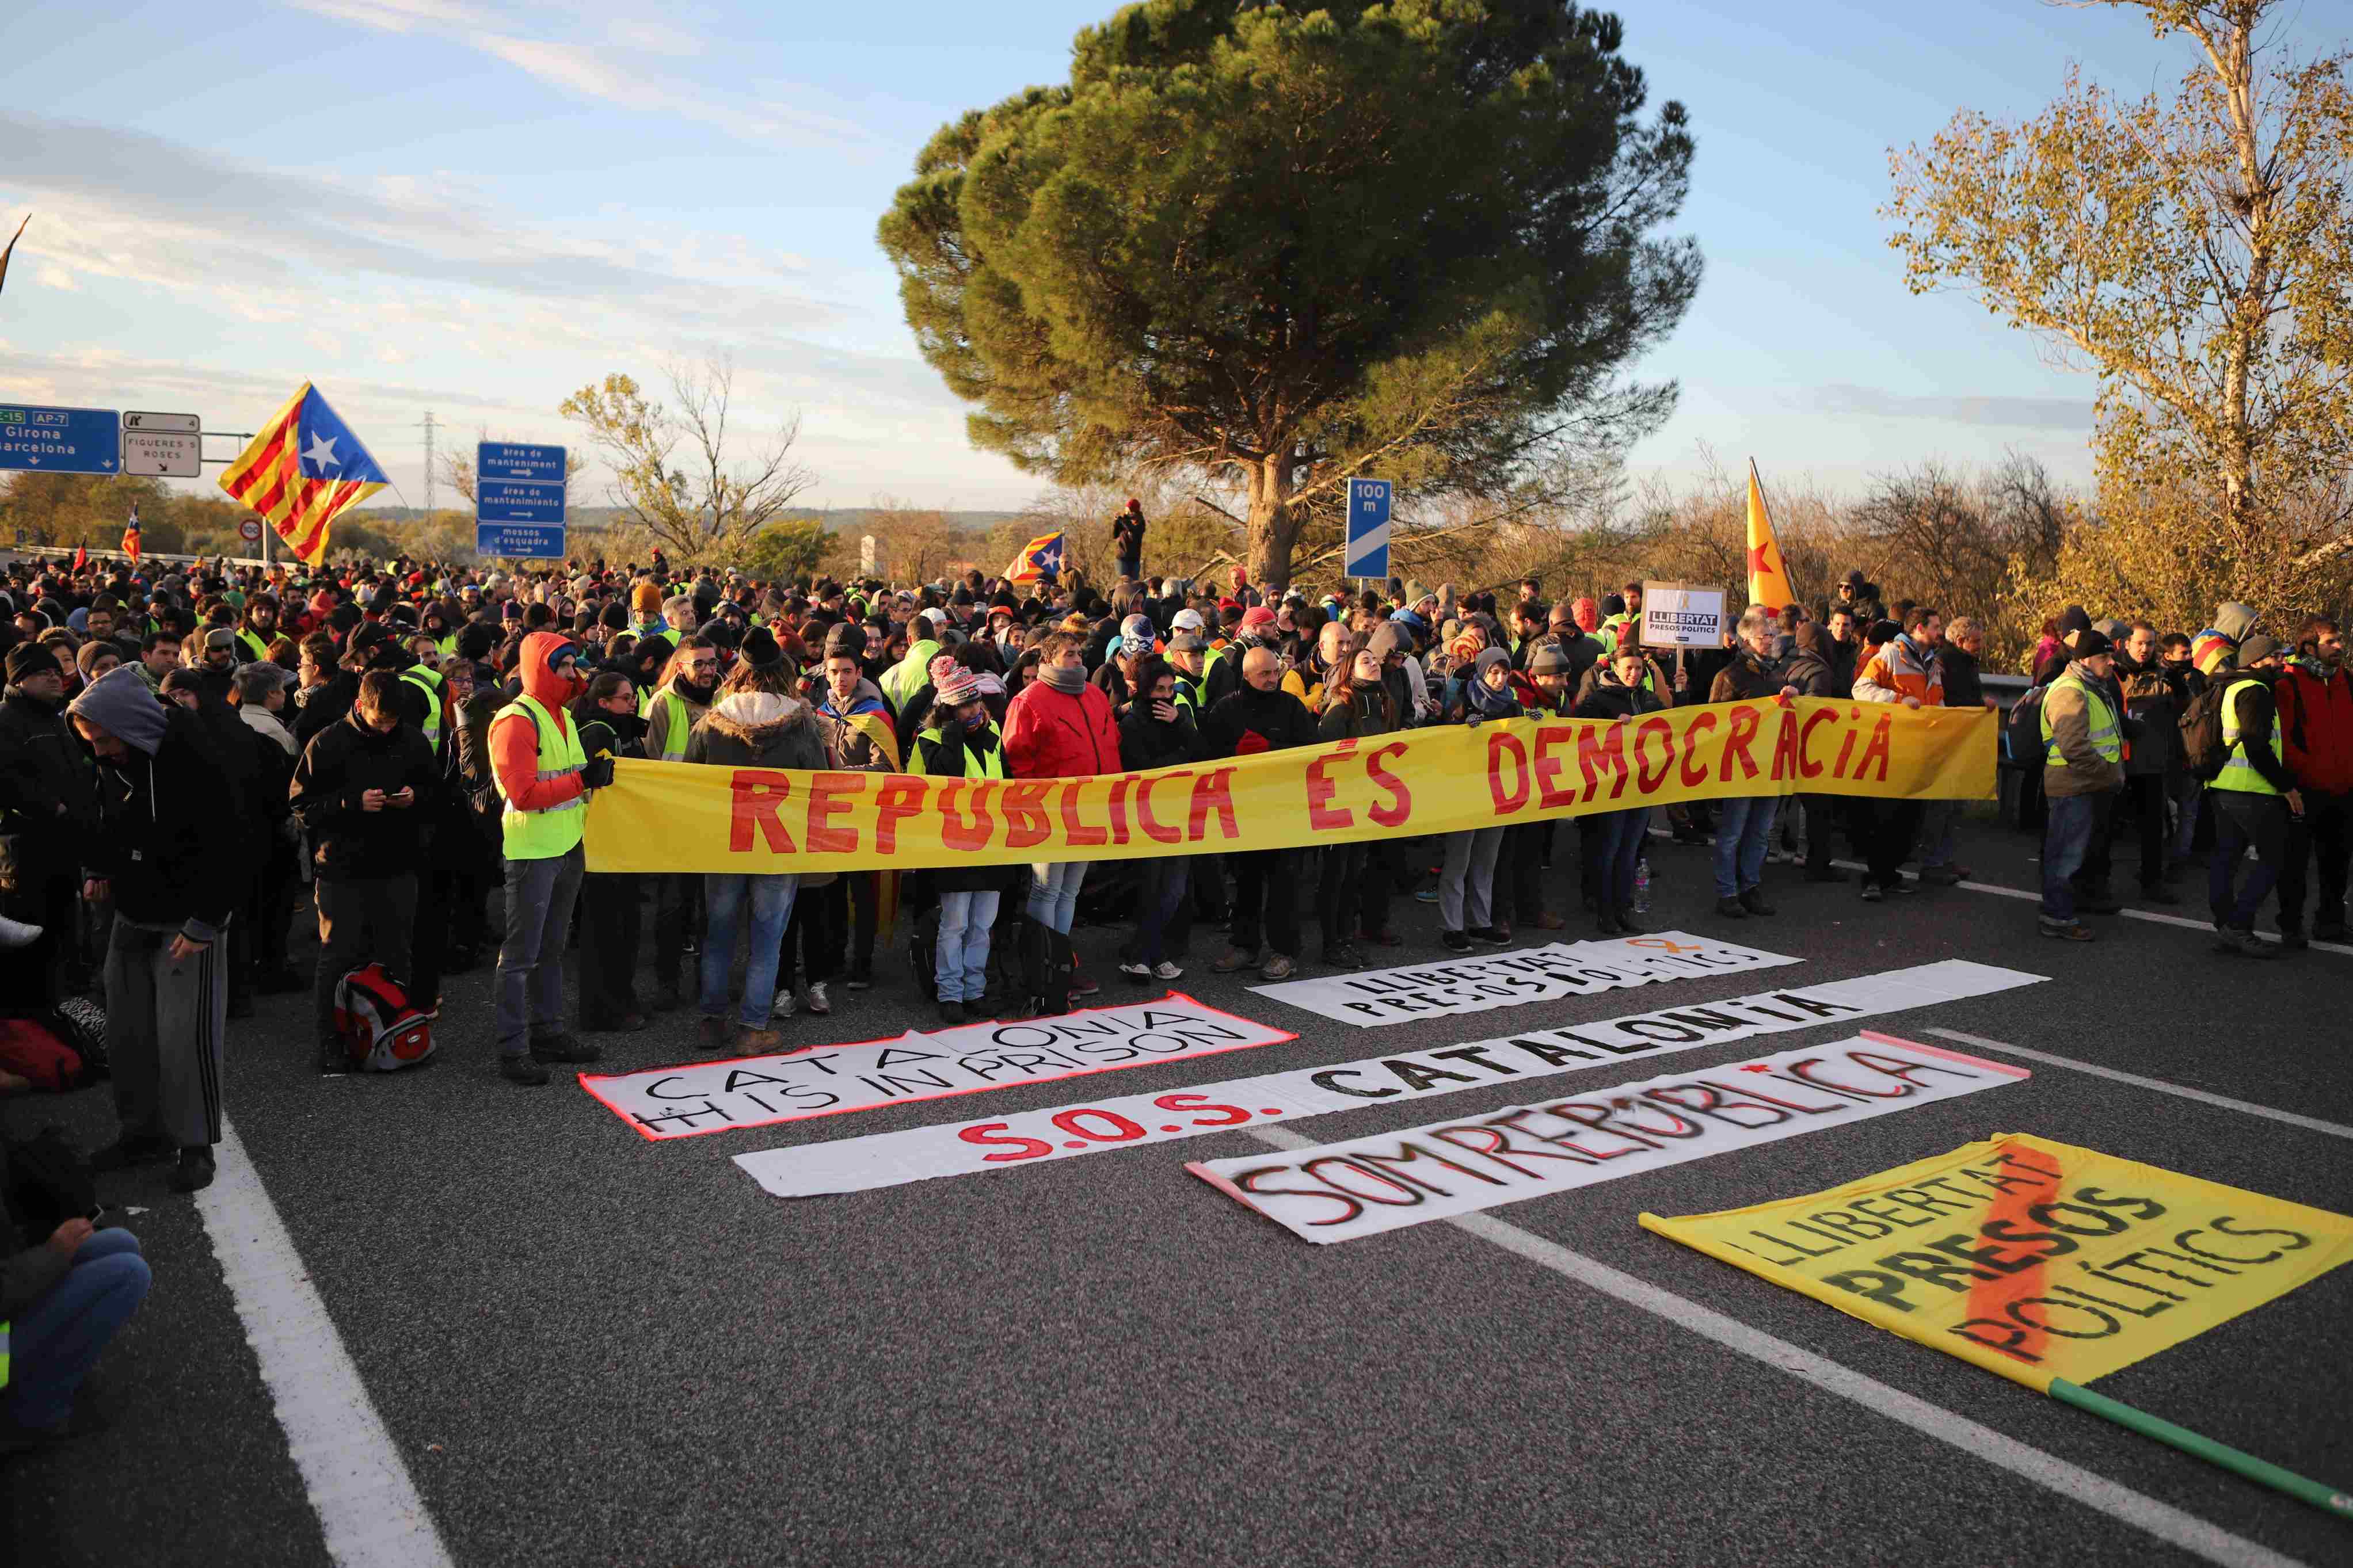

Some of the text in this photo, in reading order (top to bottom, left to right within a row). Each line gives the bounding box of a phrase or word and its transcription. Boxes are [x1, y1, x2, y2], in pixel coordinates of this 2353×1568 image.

[37, 414, 65, 424] AP-7
[6, 426, 60, 439] Girona
[0, 442, 75, 454] arcelona
[128, 438, 183, 448] FIGUERES
[143, 451, 180, 459] ROSES
[530, 448, 542, 457] de
[488, 459, 557, 469] manteniment
[530, 488, 540, 496] de
[1357, 484, 1384, 498] 100
[484, 497, 559, 506] mantenimiento
[1363, 501, 1376, 512] m
[503, 528, 539, 536] mossos
[494, 536, 549, 547] d'esquadra
[1651, 612, 1715, 625] LLIBERTAT
[1650, 623, 1716, 634] PRESOS POLÍTICS
[1306, 738, 1411, 830] ÉS
[1342, 976, 1548, 1017] PRESOS
[957, 1094, 1283, 1161] S.O.S.
[1819, 1187, 2167, 1312] PRESOS
[1948, 1216, 2312, 1363] POLÍTICS
